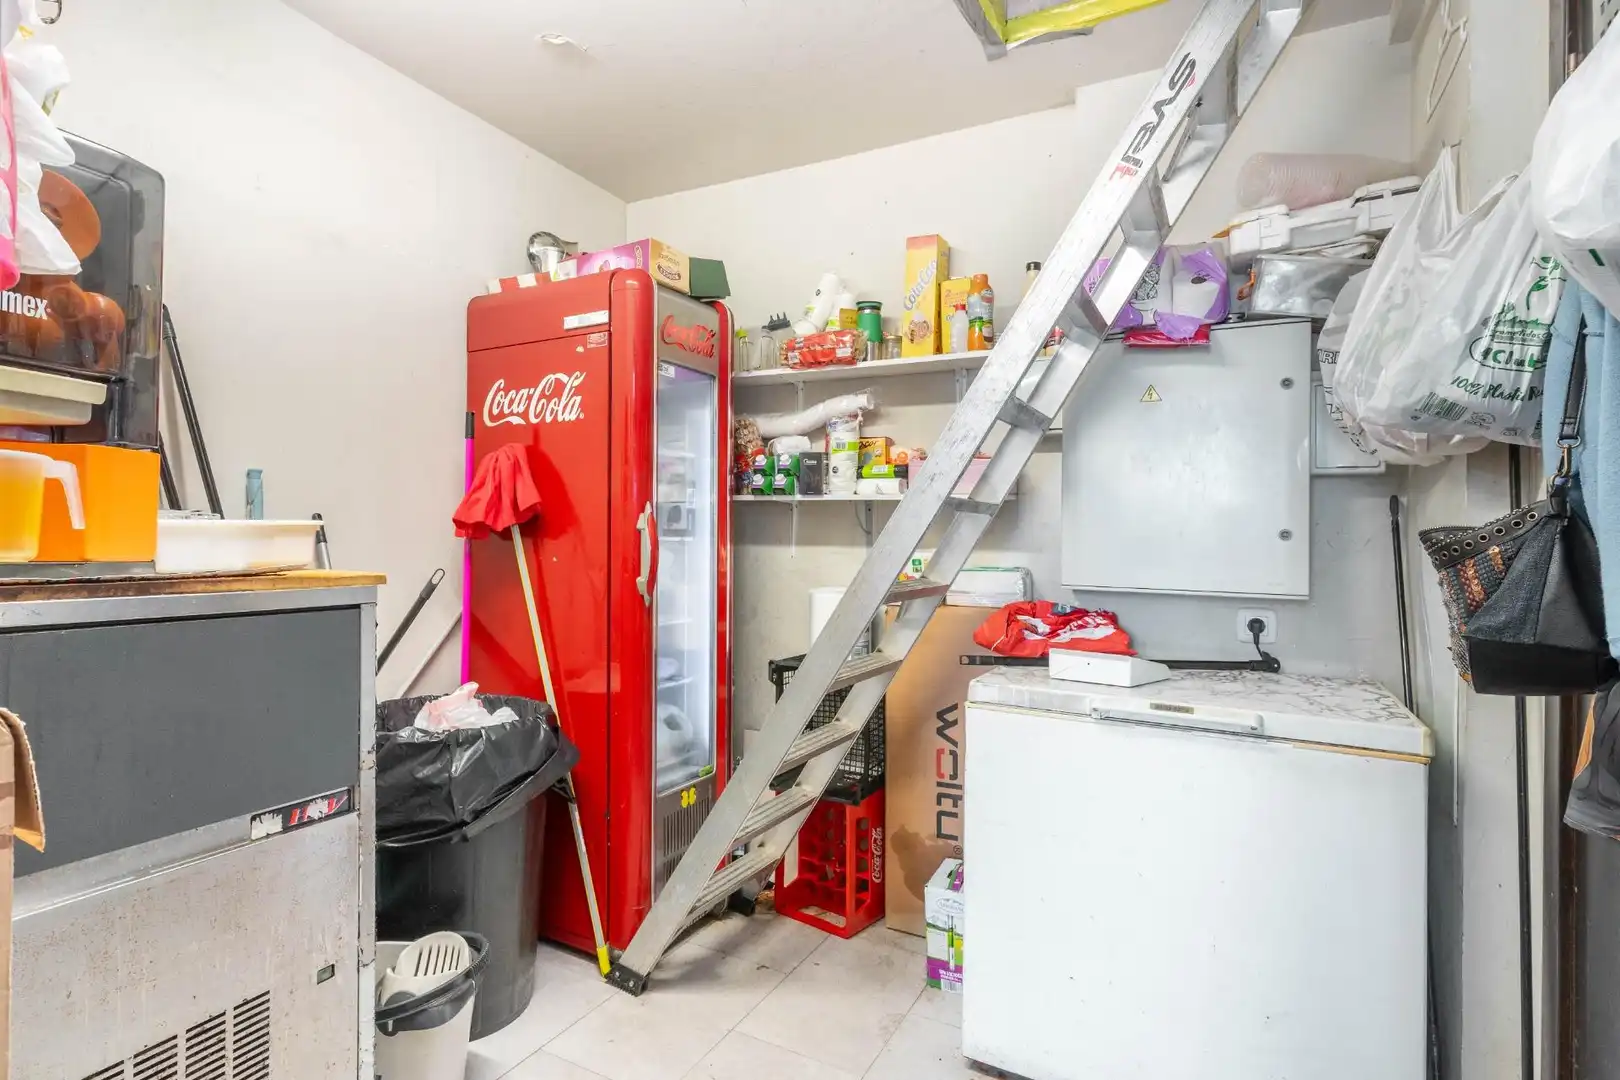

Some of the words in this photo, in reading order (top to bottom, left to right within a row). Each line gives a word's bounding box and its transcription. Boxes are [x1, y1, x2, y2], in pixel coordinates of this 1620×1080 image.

[0, 290, 48, 320] mex
[483, 371, 587, 428] Coca-Cola
[1450, 375, 1485, 396] 100%
[871, 826, 883, 884] Coca-Cola
